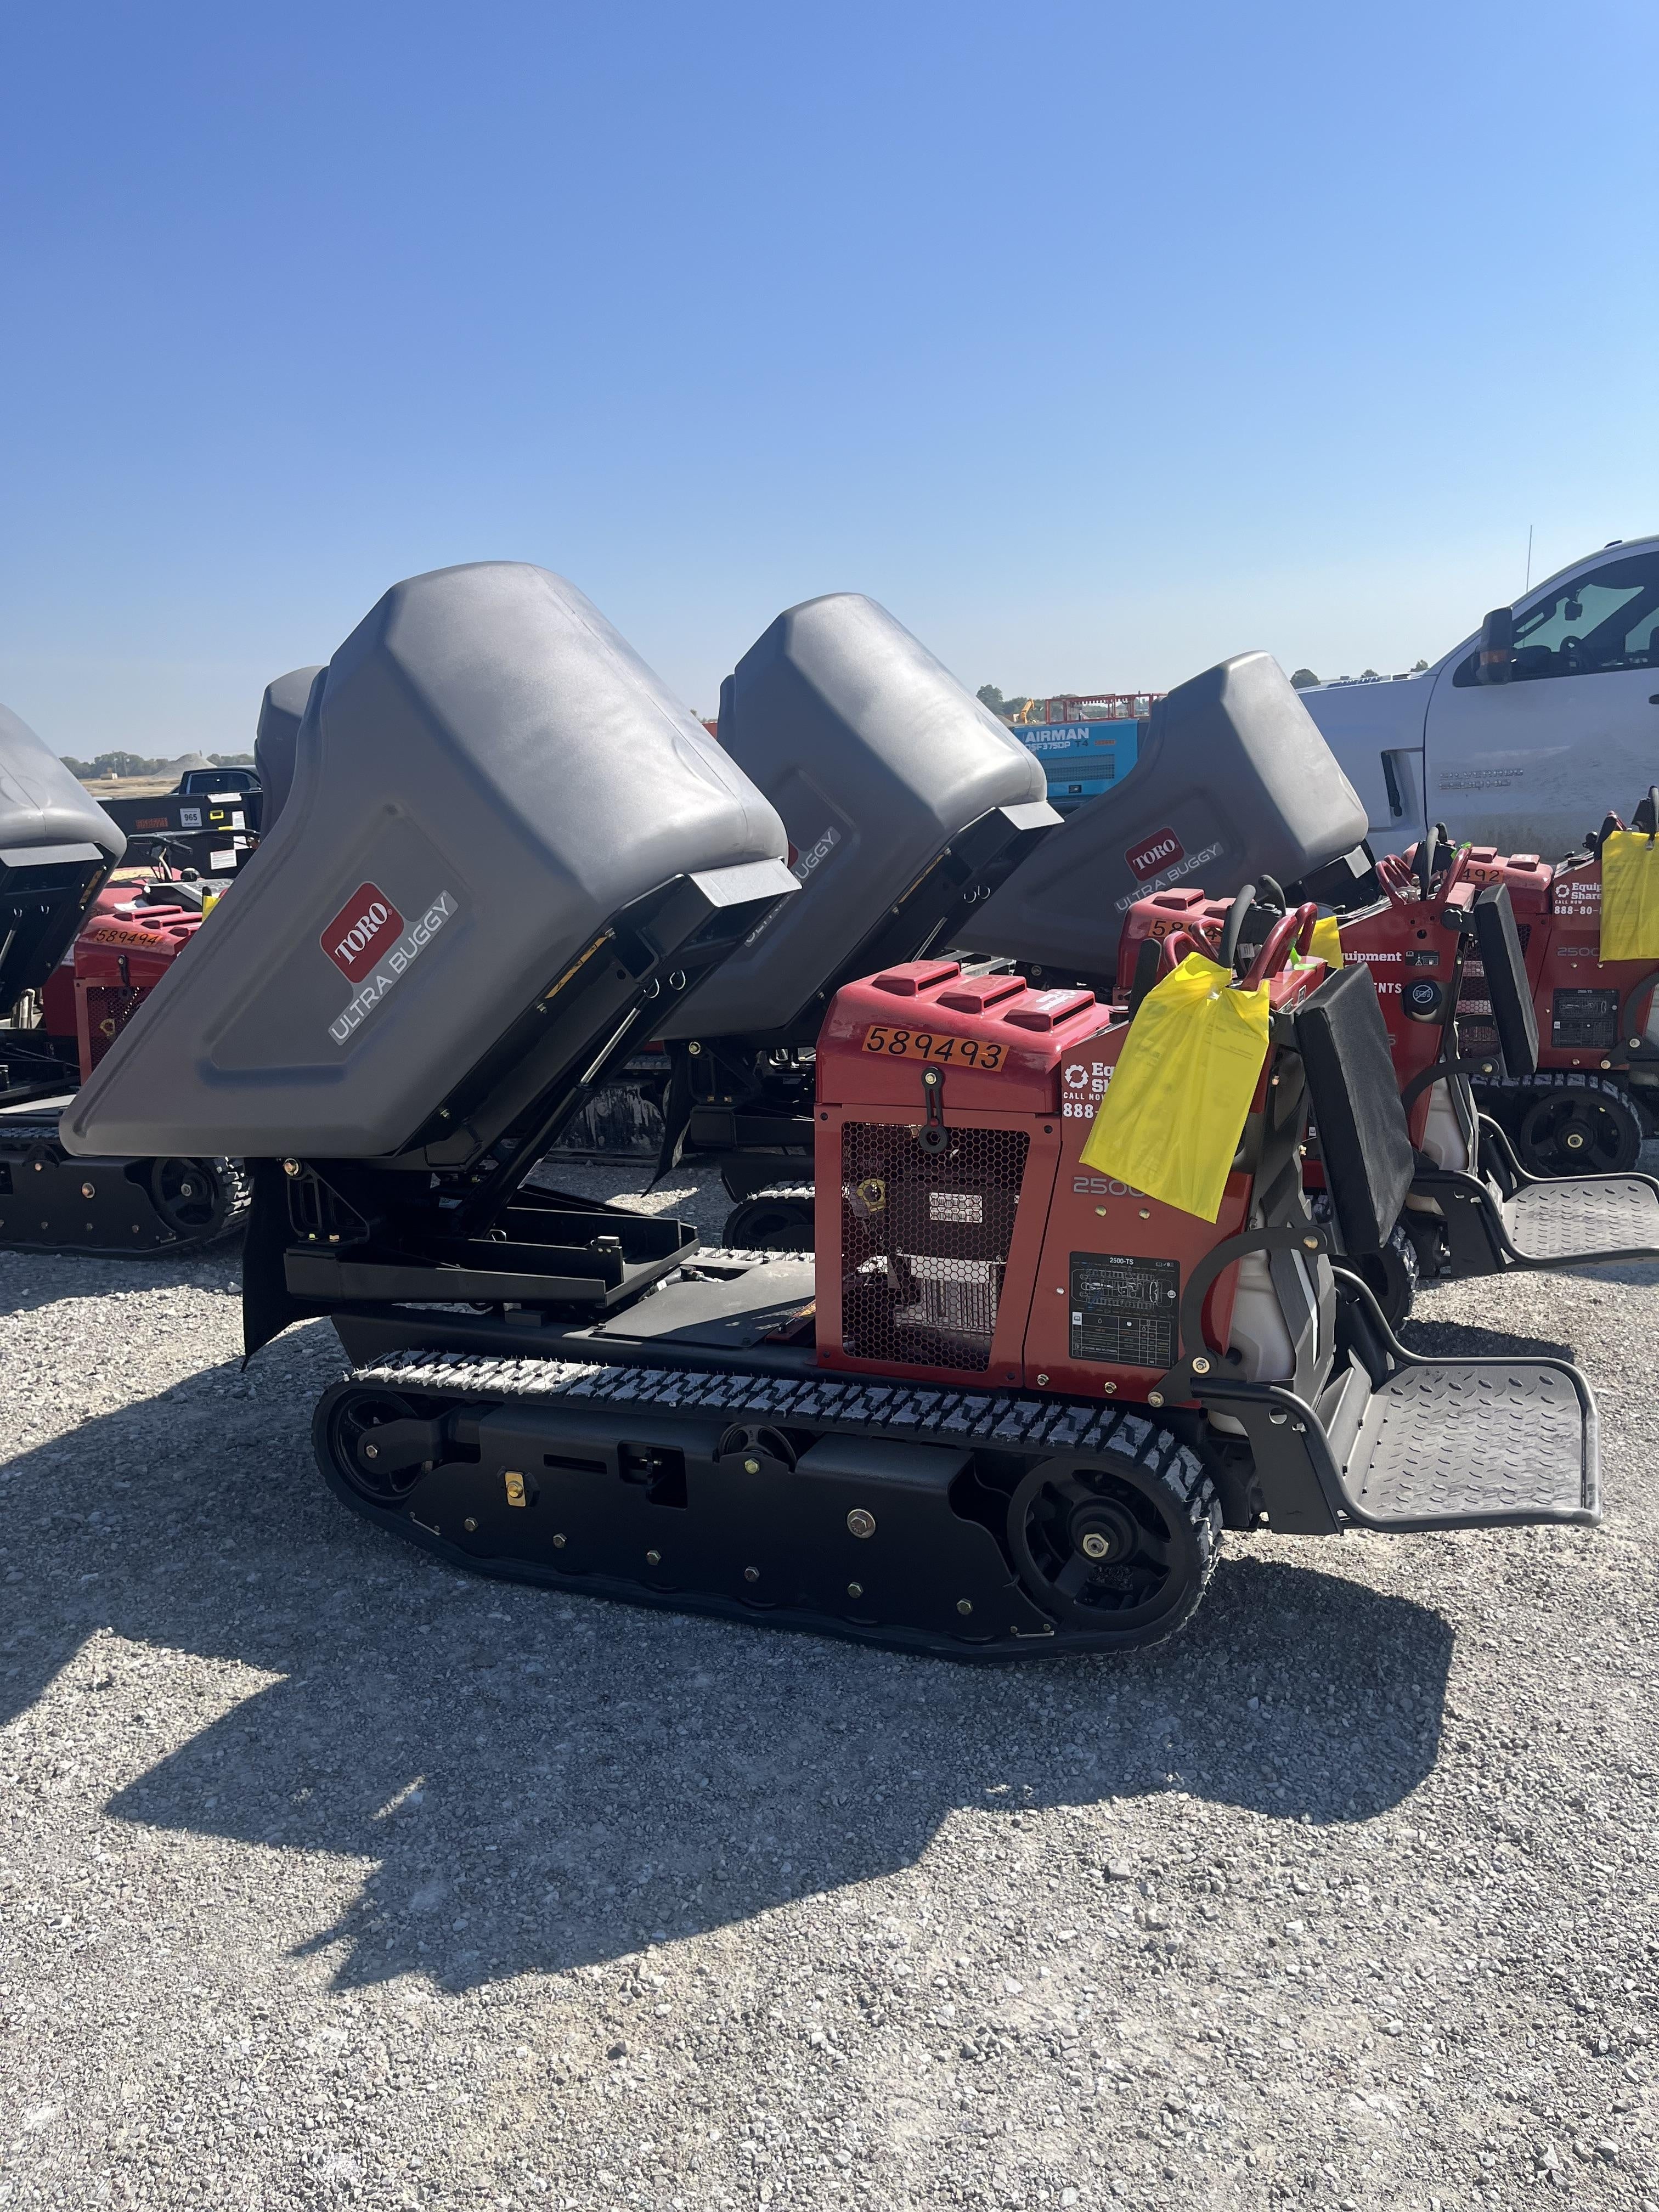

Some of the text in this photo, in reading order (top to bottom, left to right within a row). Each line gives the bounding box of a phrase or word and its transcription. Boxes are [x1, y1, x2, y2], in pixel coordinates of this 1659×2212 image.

[1025, 728, 1089, 742] AIRMAN
[794, 830, 834, 882] UGGY
[1132, 839, 1176, 870] TORO
[1167, 844, 1216, 882] BUGGY
[1463, 868, 1499, 882] 492
[1572, 882, 1601, 891] Equip
[1554, 906, 1601, 915] 888-80-
[97, 930, 160, 945] 589494
[334, 902, 387, 965] TORO
[1342, 951, 1402, 964] uipment
[331, 896, 449, 1039] ULTRA BUGGY
[1374, 983, 1402, 994] NTS
[867, 1028, 1002, 1069] 589493
[1092, 1062, 1115, 1080] Eq
[1063, 1092, 1085, 1100] CALL
[1063, 1103, 1098, 1119] 888-
